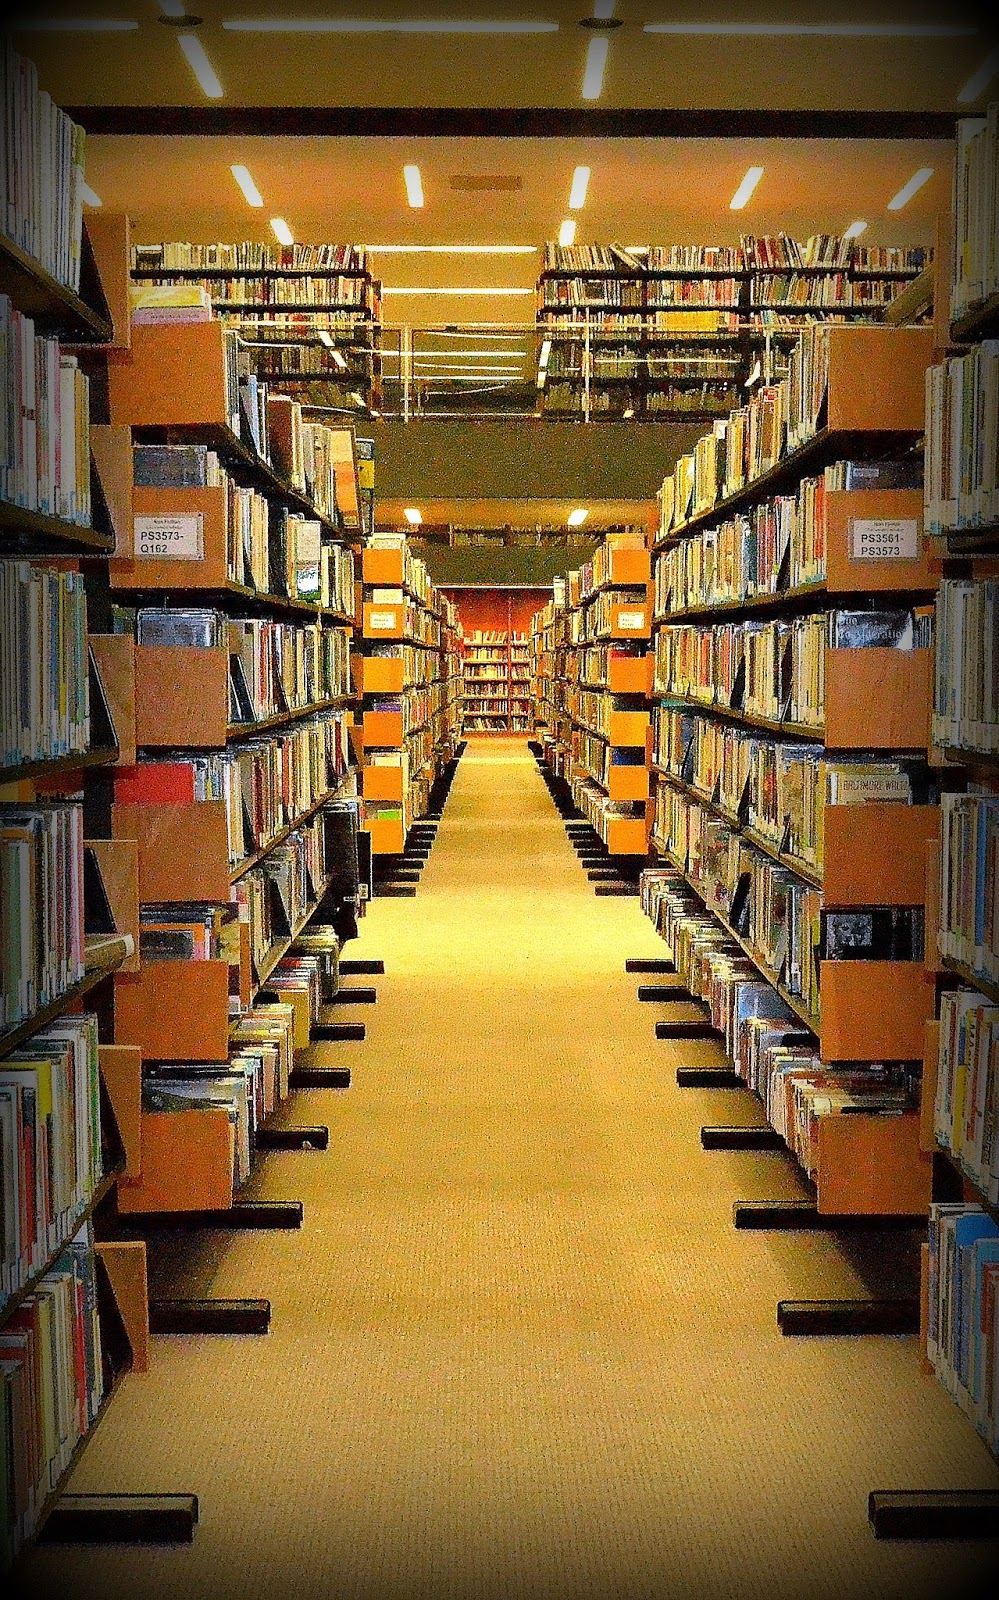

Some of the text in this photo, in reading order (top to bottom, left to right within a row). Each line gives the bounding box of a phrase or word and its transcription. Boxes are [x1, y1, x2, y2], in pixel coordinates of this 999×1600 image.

[141, 531, 184, 541] PS3573-
[861, 533, 904, 543] PS3561-
[141, 544, 168, 553] Q162
[861, 546, 900, 556] PS3573
